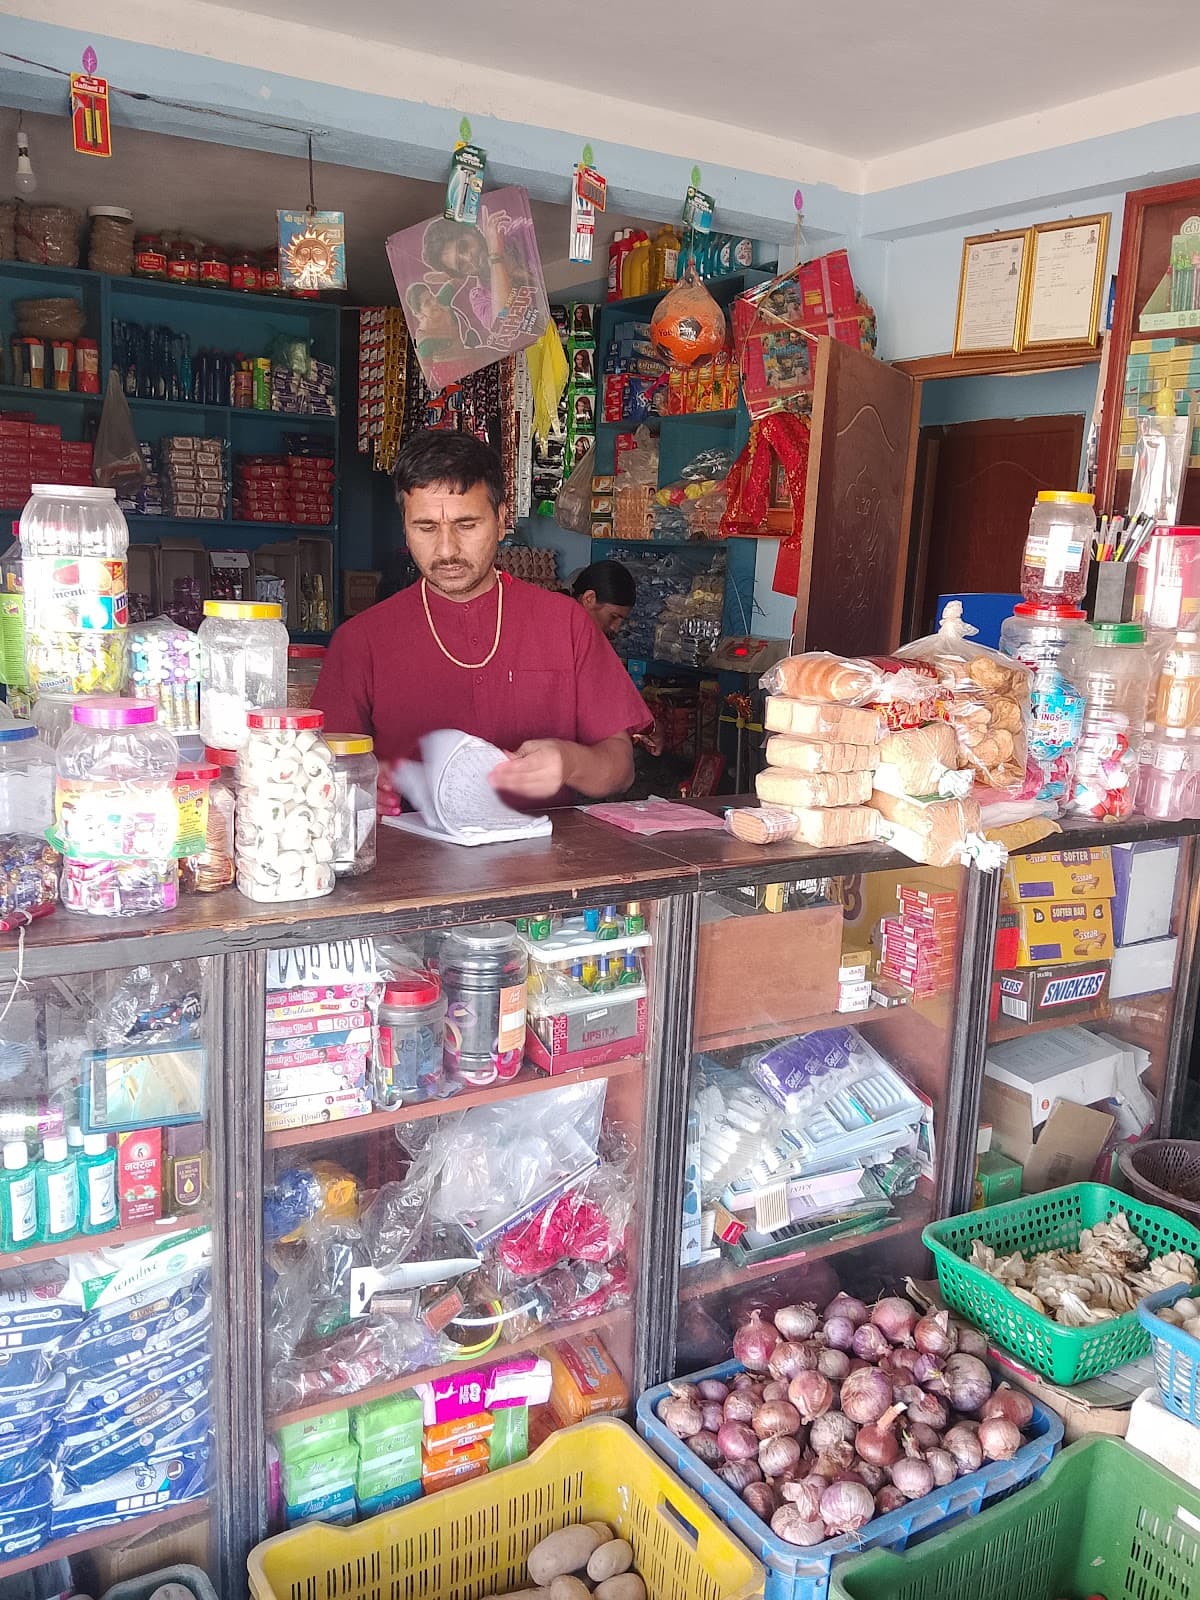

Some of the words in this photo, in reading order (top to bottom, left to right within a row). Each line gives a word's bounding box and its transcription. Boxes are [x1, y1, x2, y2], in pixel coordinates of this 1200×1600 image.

[1063, 850, 1089, 862] SOFTER
[1052, 907, 1073, 918] SOFTER
[1073, 906, 1085, 917] BAR
[1043, 974, 1104, 1004] SNICKERS
